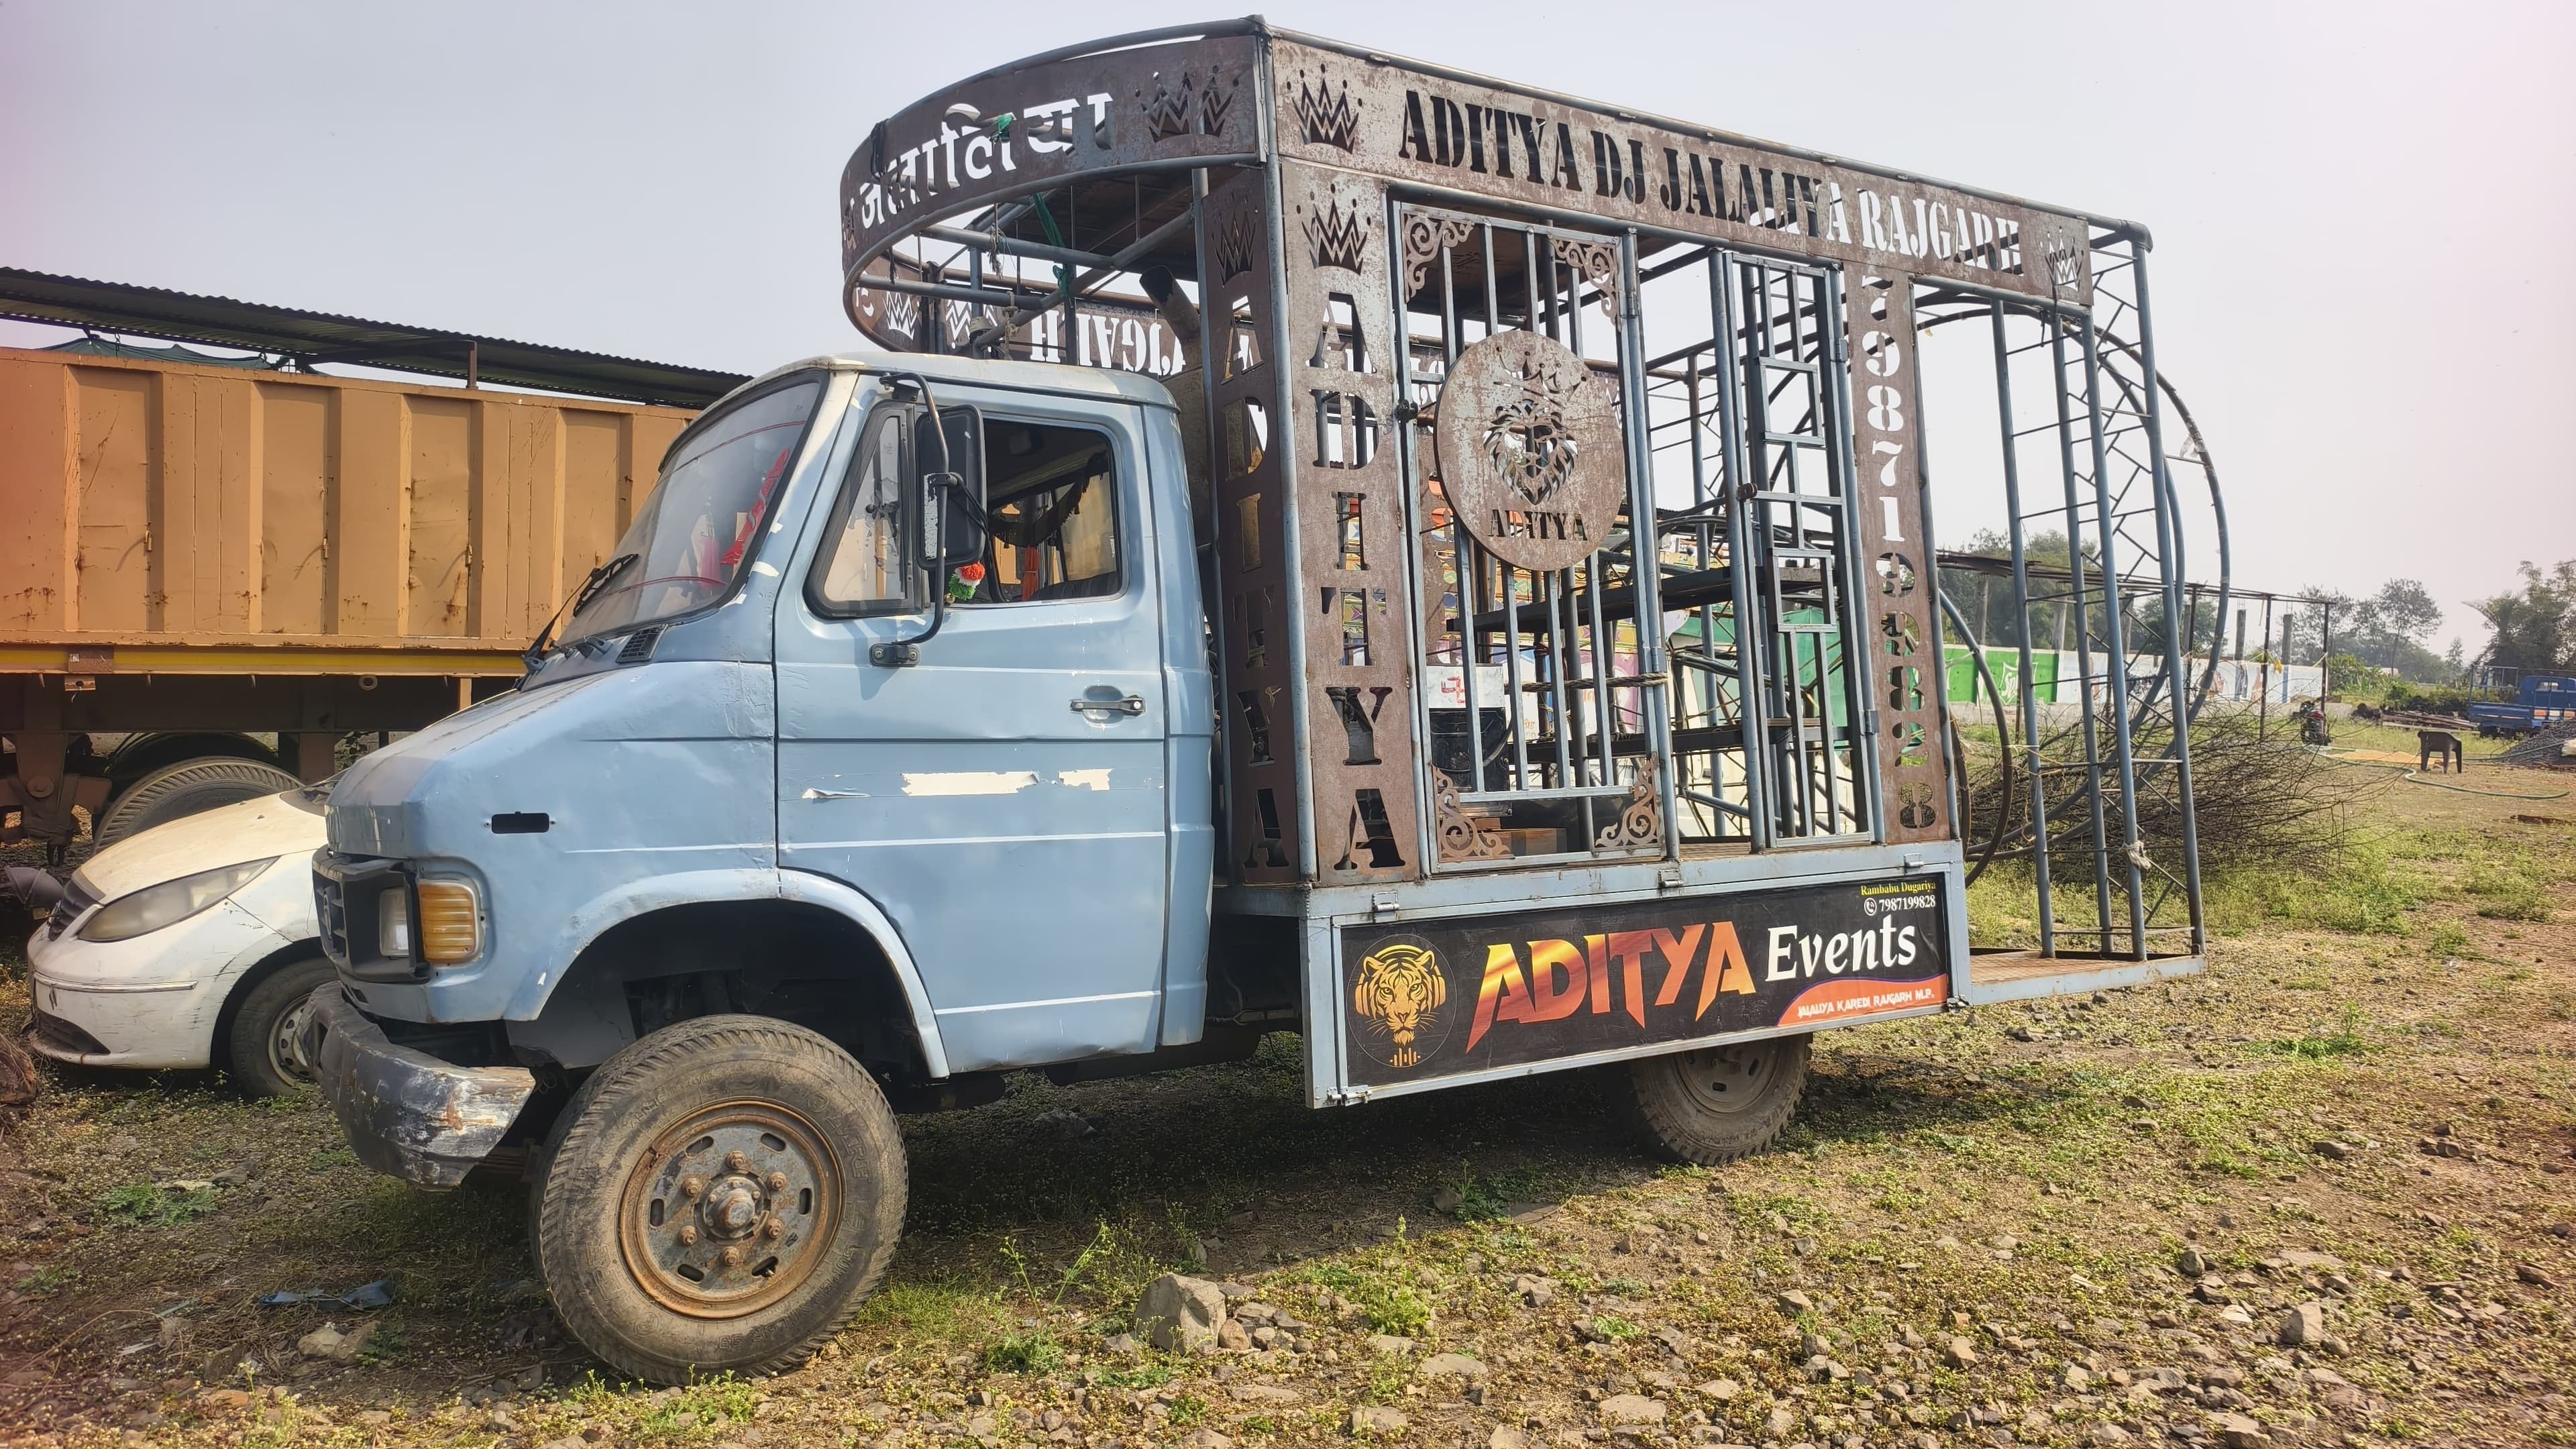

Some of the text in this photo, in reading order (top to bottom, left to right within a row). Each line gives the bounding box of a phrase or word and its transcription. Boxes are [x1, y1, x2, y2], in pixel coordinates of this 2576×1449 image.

[1398, 90, 1582, 192] ADITYA
[1591, 129, 1646, 205] DJ
[1857, 188, 2025, 276] RAJGARH
[1487, 508, 1588, 541] ADITYA
[1305, 292, 1406, 870] ADITYA
[1860, 880, 1936, 896] Rambabu Dugariya
[1878, 895, 1936, 912] 7987199828
[1467, 914, 1917, 1054] ADITYA Events
[1837, 997, 1870, 1012] KAREDI
[1873, 991, 1912, 1007] RAJGARH
[1915, 988, 1934, 1000] M.P.
